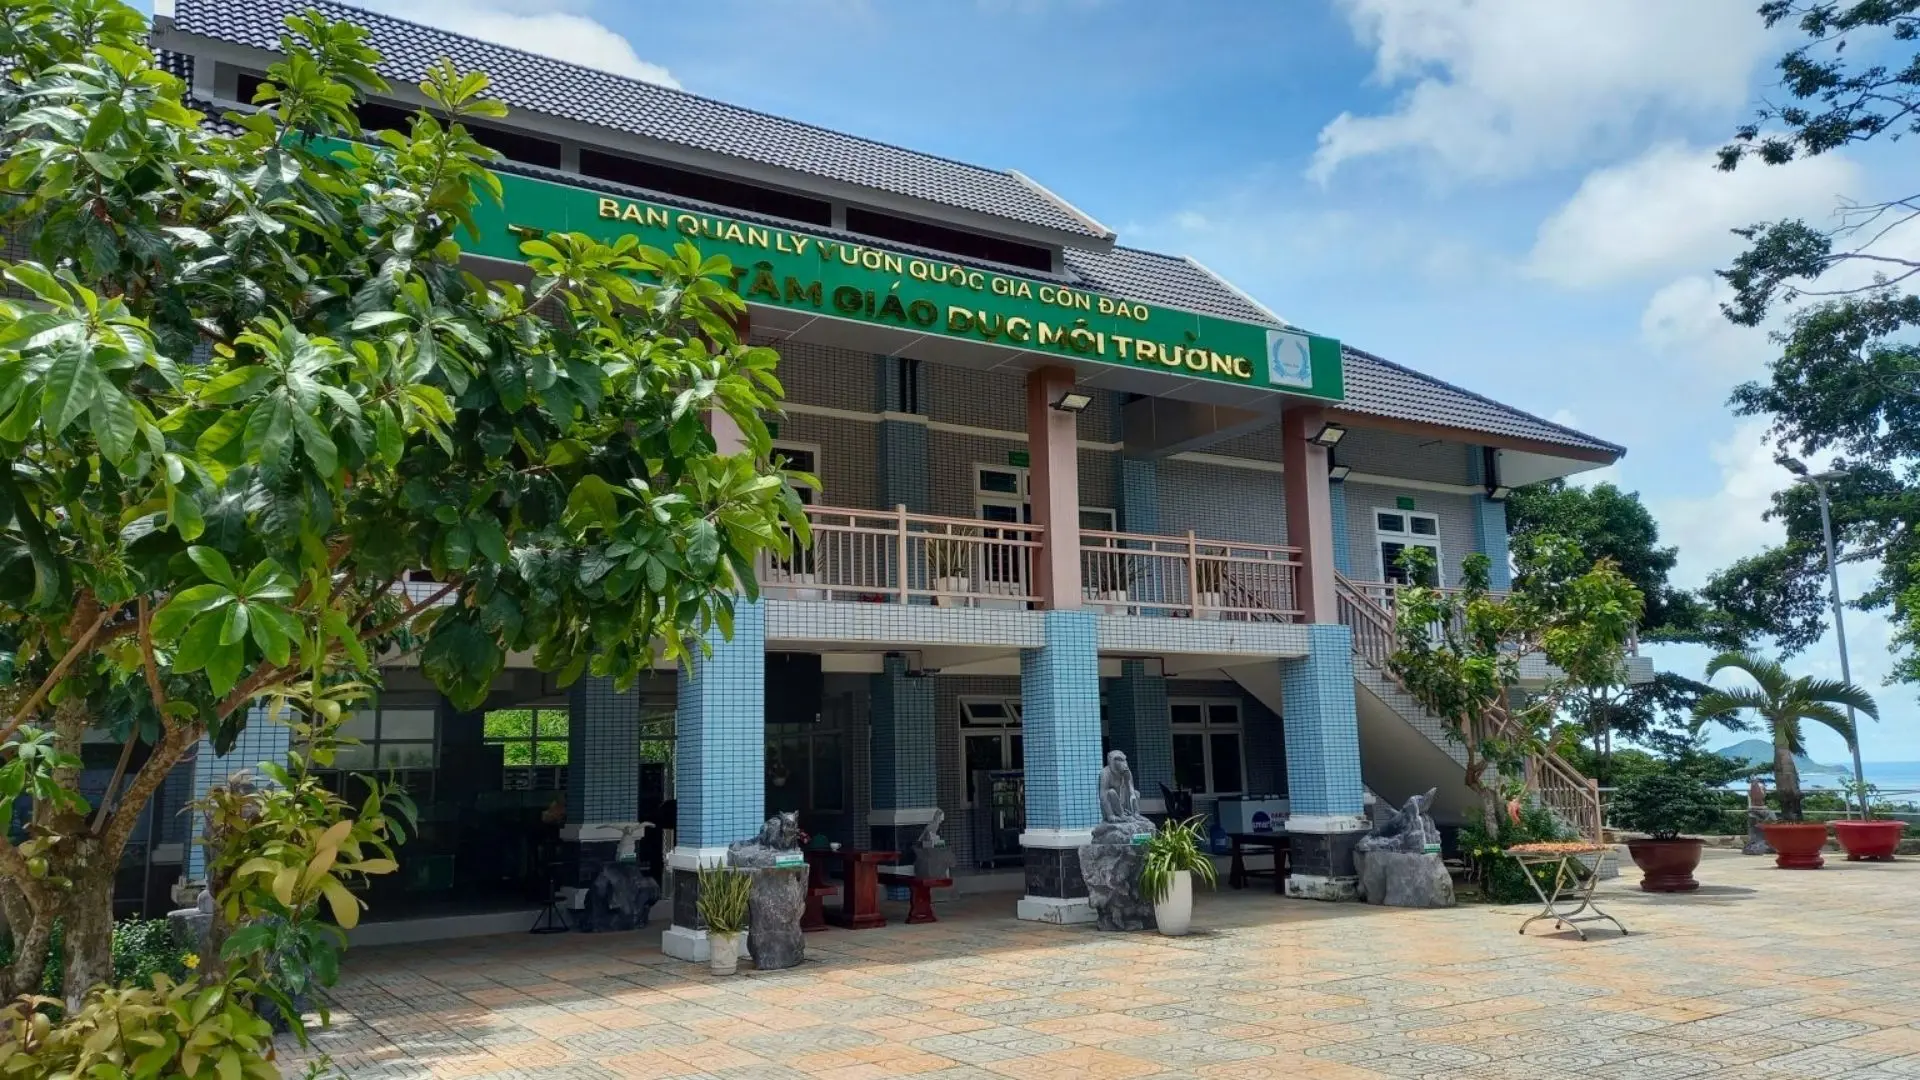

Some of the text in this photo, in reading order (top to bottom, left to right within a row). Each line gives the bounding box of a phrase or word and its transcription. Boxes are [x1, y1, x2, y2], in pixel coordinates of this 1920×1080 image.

[600, 197, 668, 230] BAN
[776, 232, 809, 255] LÝ
[991, 276, 1032, 300] GIA
[1039, 285, 1090, 311] CÔN
[833, 280, 938, 326] GIÁO
[948, 305, 1032, 343] DỤC
[1038, 318, 1105, 355] MÔI
[1111, 329, 1254, 379] TRƯỜNG
